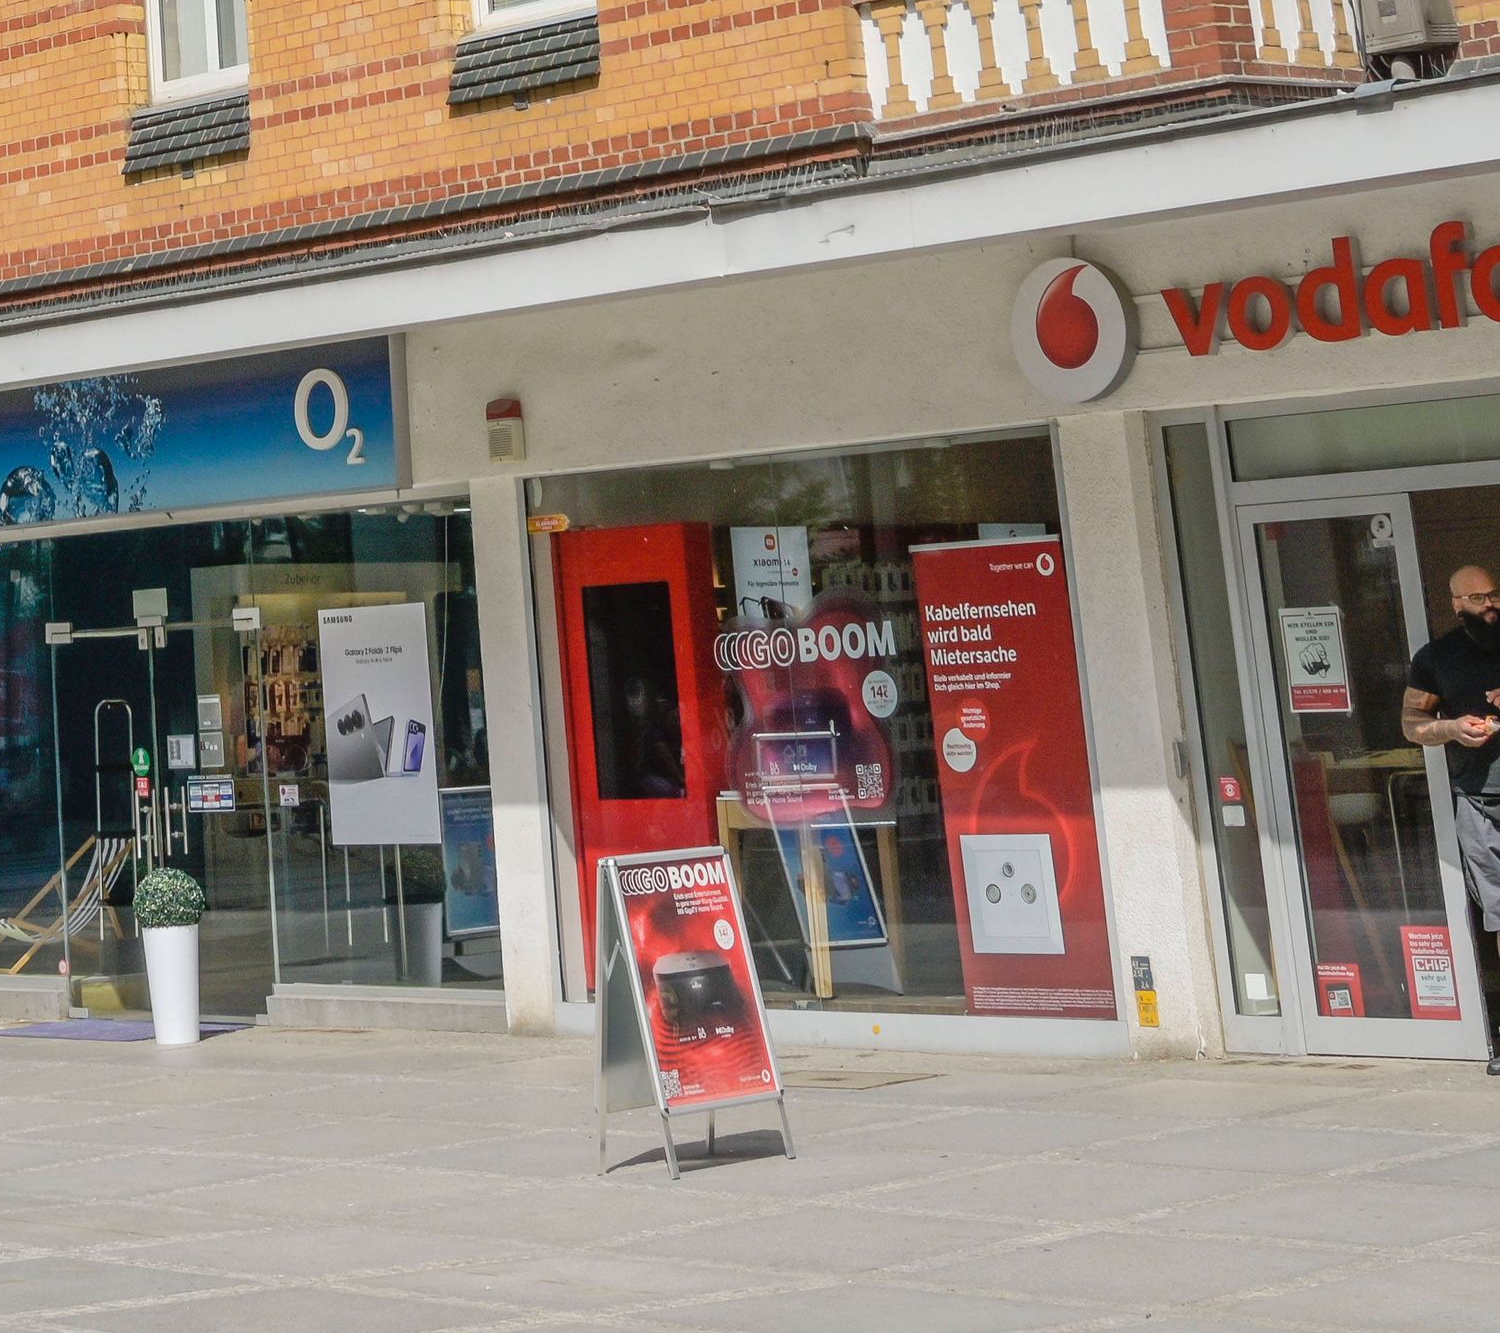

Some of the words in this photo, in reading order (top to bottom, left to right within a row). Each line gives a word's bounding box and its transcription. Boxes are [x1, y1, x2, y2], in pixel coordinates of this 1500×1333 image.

[989, 563, 1013, 573] Together
[925, 600, 1036, 622] Kabelfernsehen
[323, 615, 352, 624] SAMSUNG
[927, 627, 958, 643] wird
[961, 624, 992, 642] bald
[797, 620, 897, 663] BOOM
[345, 647, 364, 657] Galaxy
[930, 646, 1017, 666] Mietersache
[935, 683, 947, 691] Dich
[948, 682, 964, 692] gleich
[965, 682, 975, 690] hier
[667, 861, 726, 889] BOOM
[1431, 933, 1443, 941] jetzt
[1410, 947, 1449, 955] Vodafone-Netz
[1414, 958, 1449, 971] CHIP
